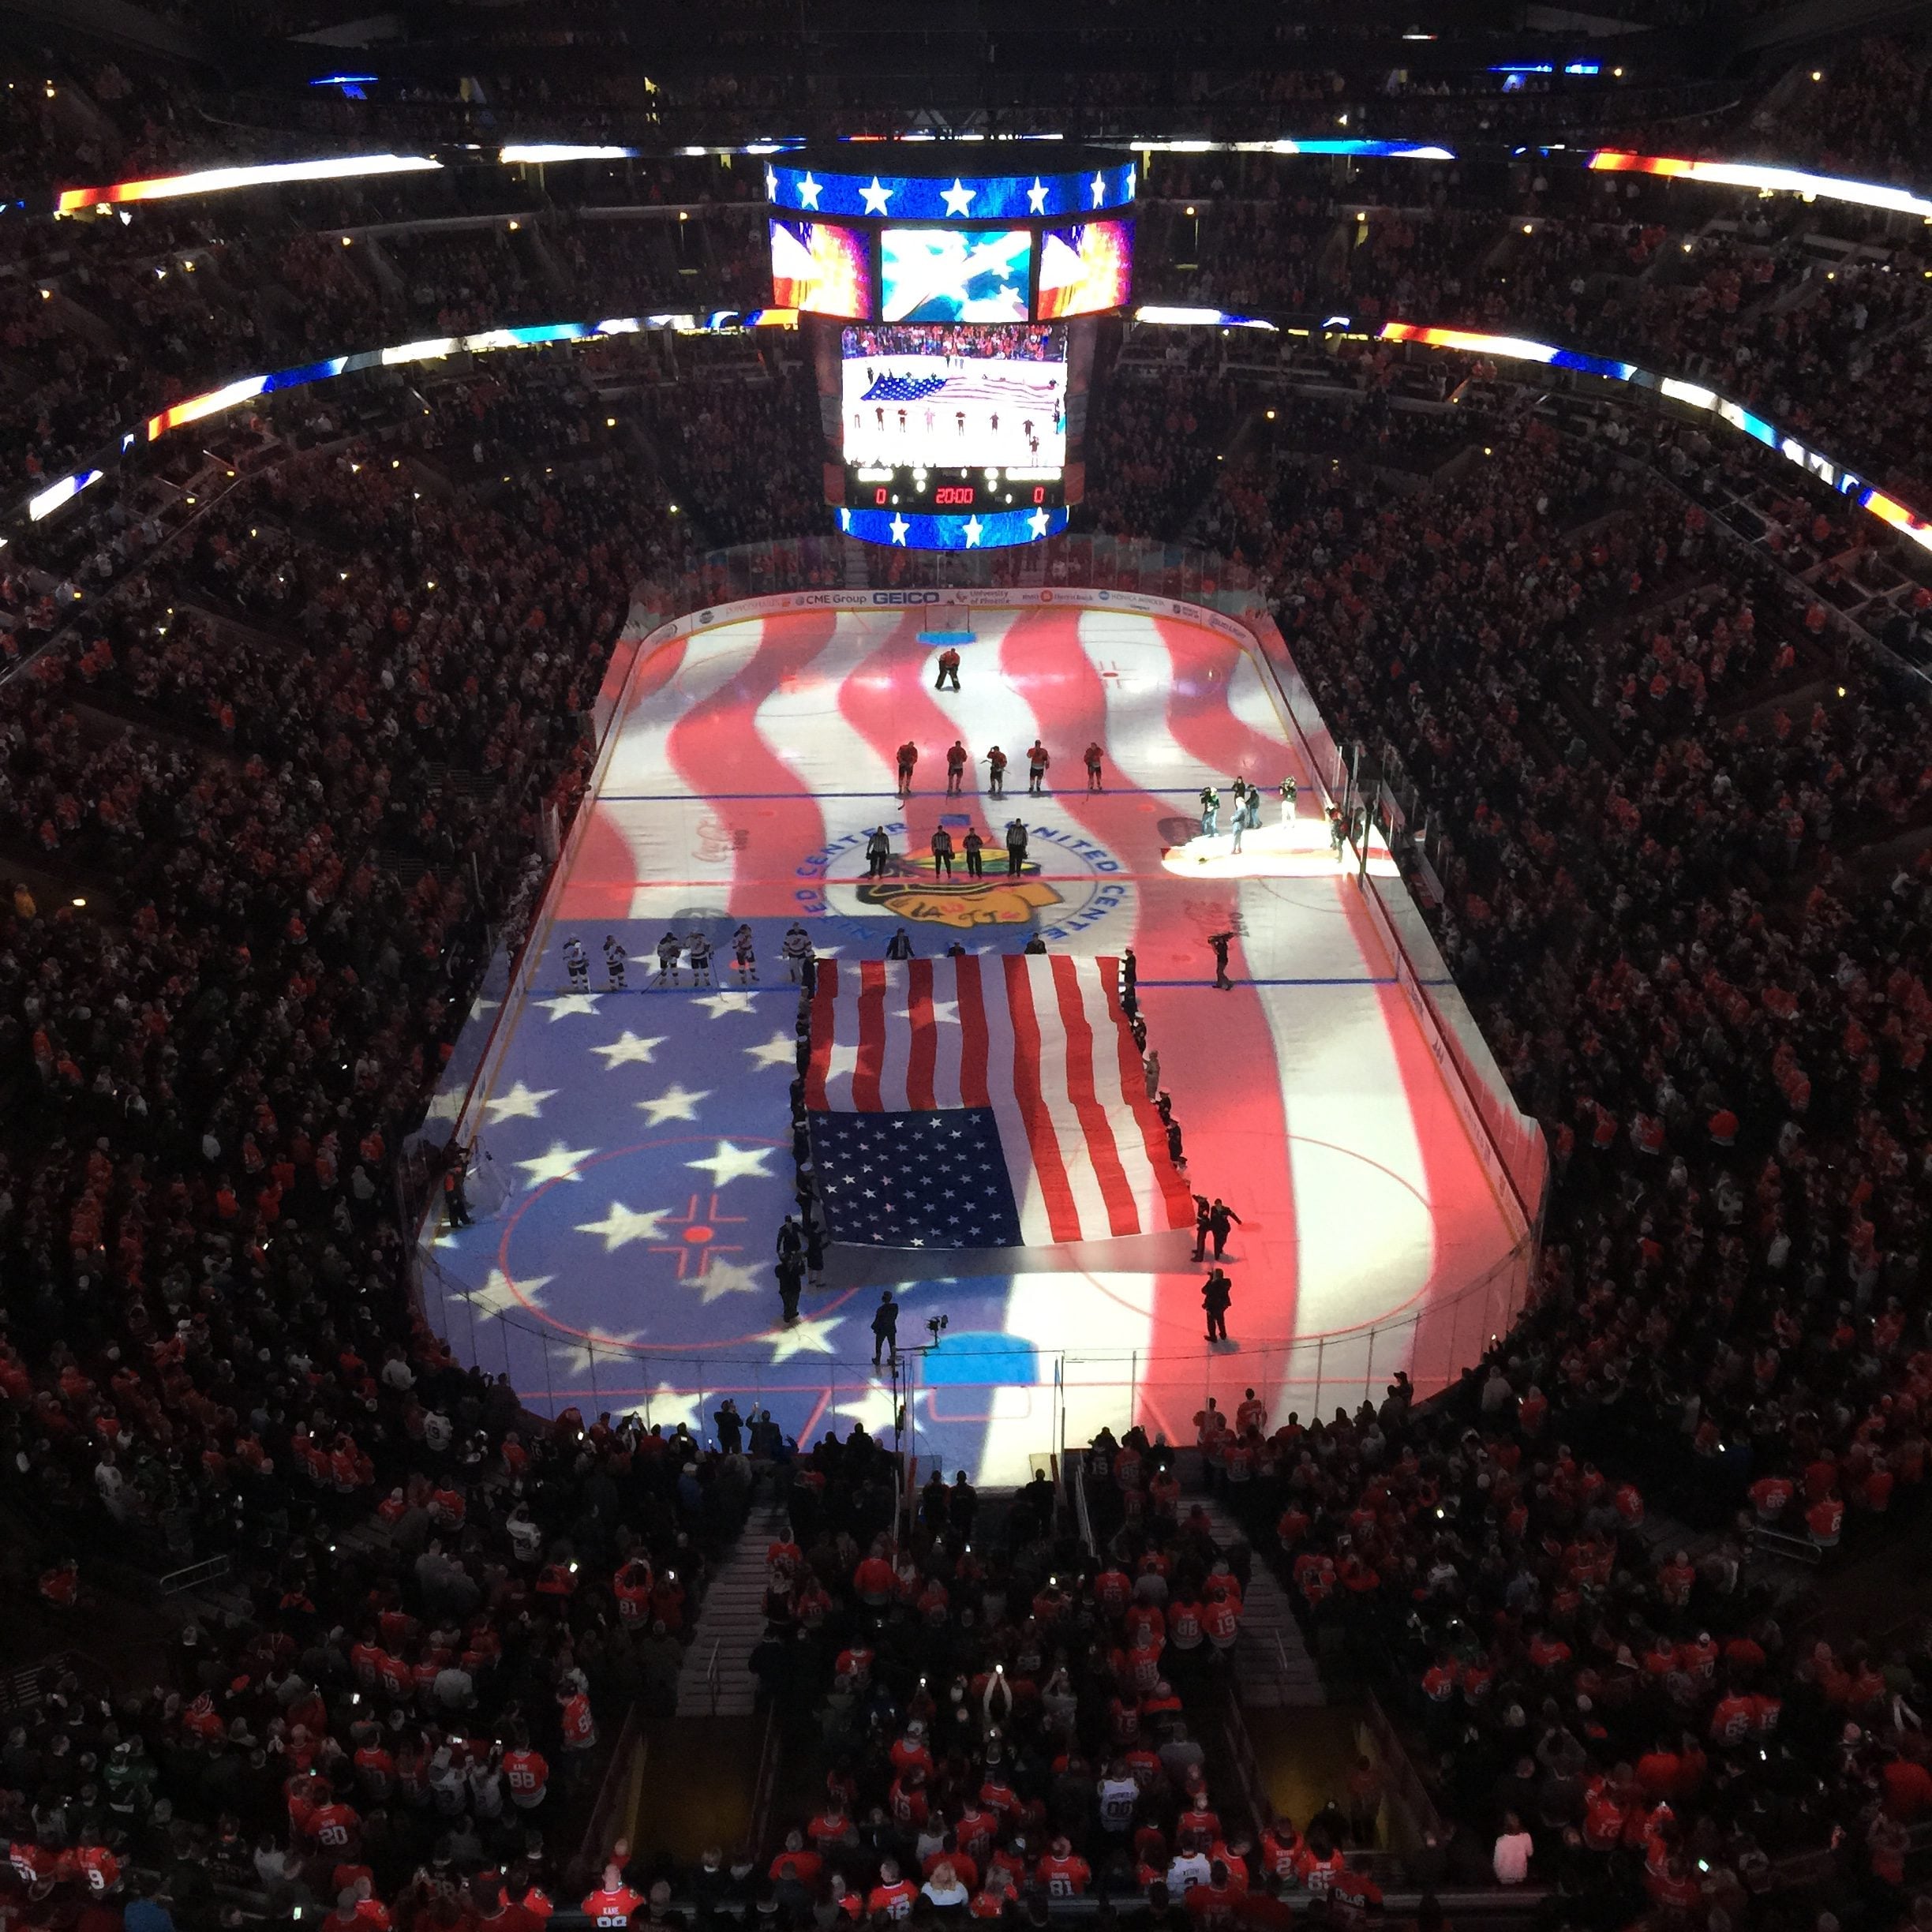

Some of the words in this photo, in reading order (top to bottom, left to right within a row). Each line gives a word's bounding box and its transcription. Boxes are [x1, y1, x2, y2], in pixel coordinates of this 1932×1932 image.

[875, 488, 886, 504] 0
[935, 488, 974, 504] 20:00
[1033, 486, 1045, 504] 0
[806, 594, 831, 605] CME
[833, 593, 867, 605] Group
[873, 592, 940, 605] GEICO
[619, 1599, 638, 1616] 81
[1216, 1615, 1236, 1635] 19
[508, 1772, 536, 1789] 88
[318, 1825, 348, 1846] 20
[1275, 1856, 1292, 1875] 2
[88, 1869, 105, 1890] 9
[1048, 1878, 1074, 1896] 81
[602, 1907, 620, 1915] KANE
